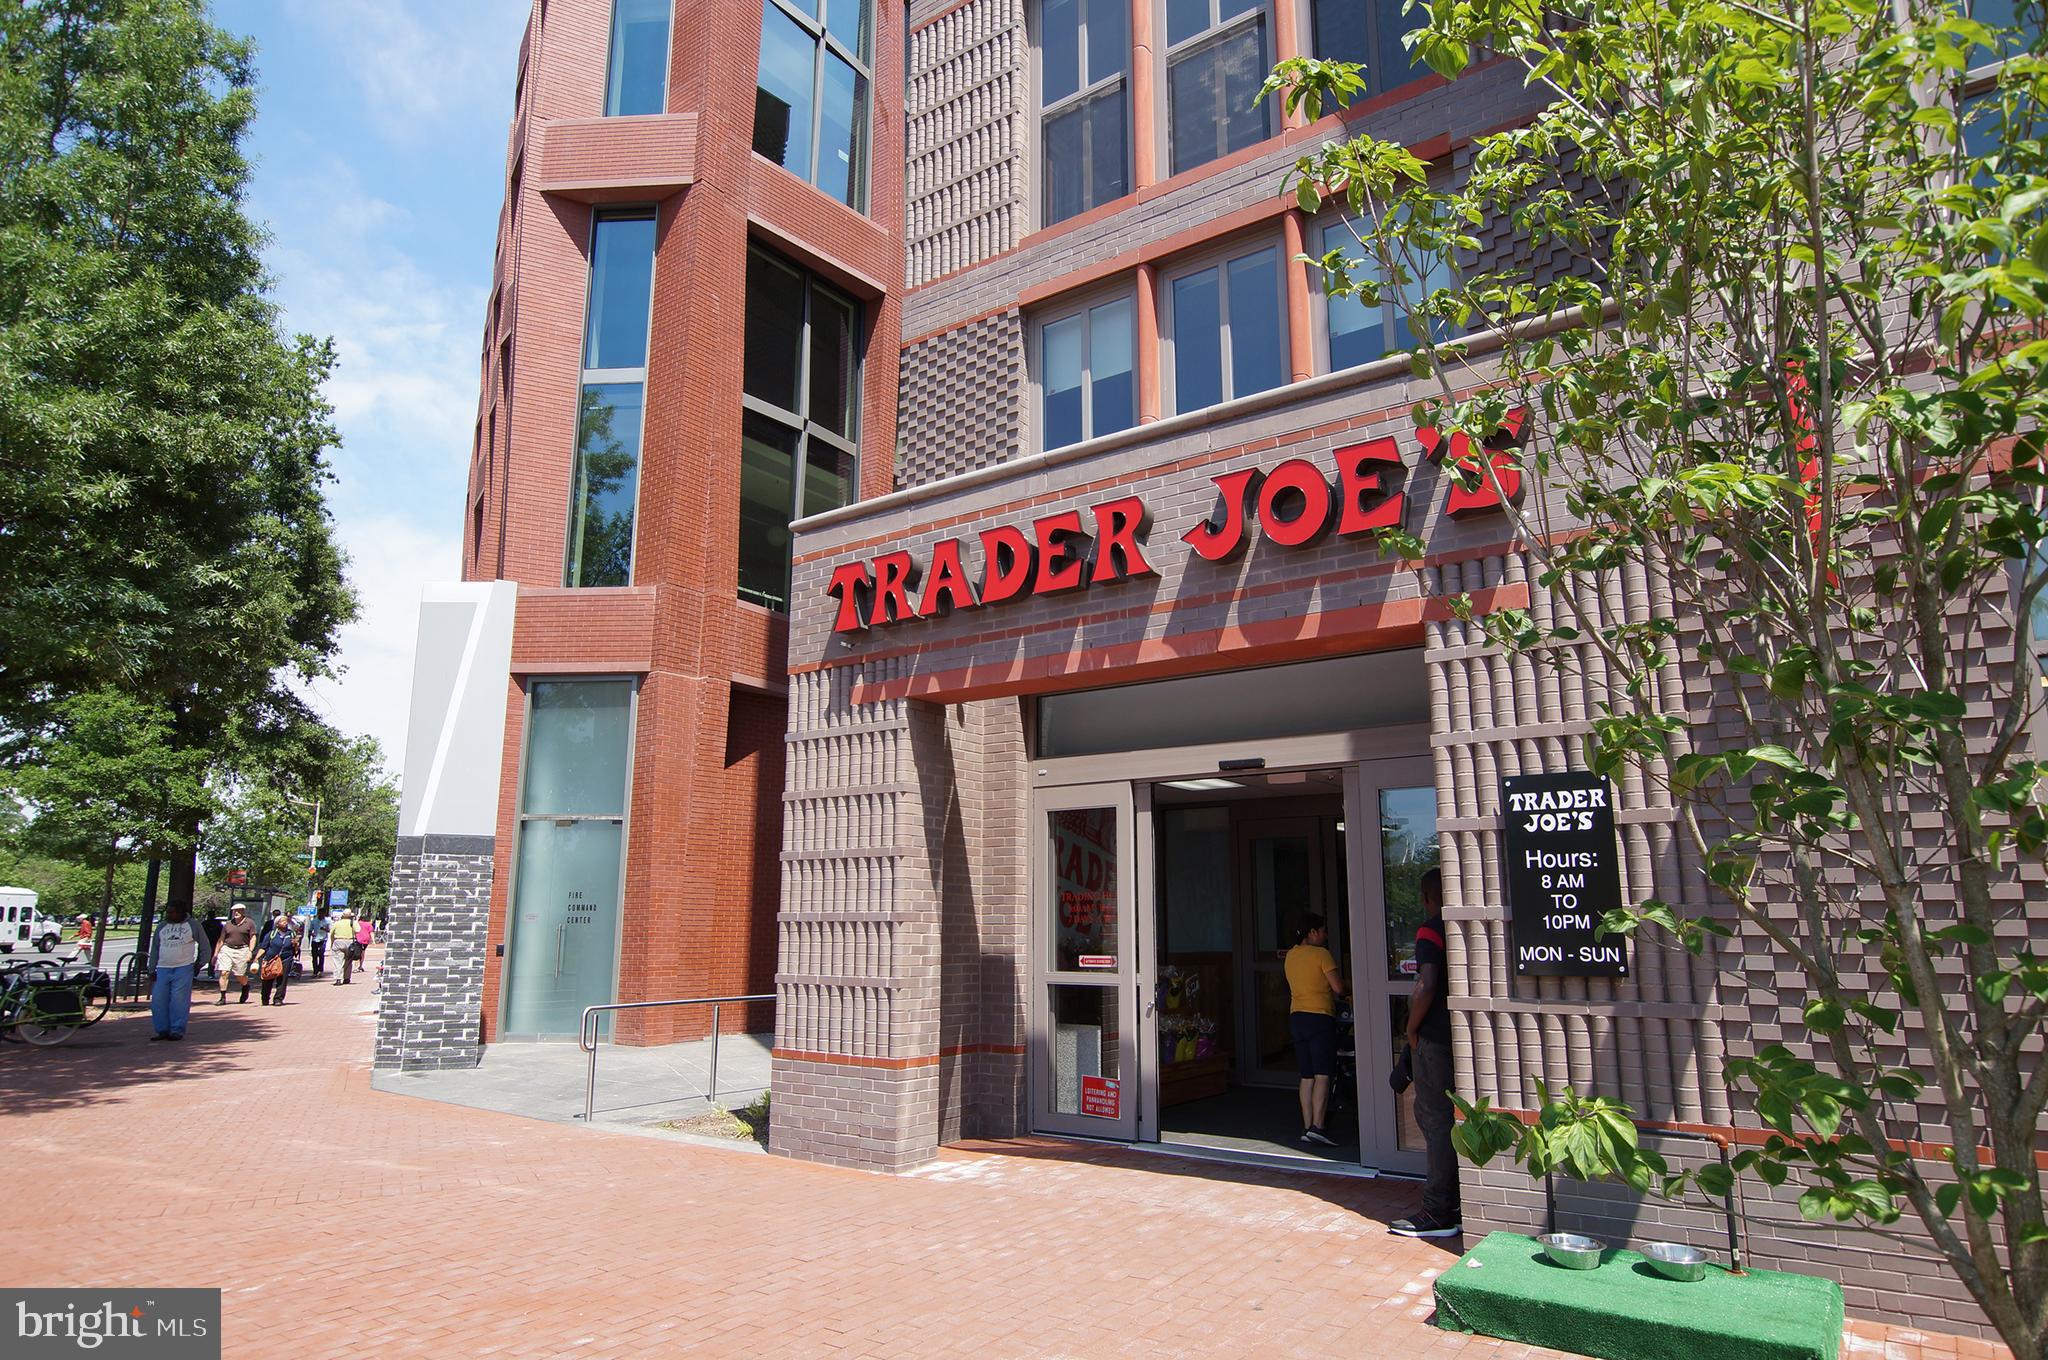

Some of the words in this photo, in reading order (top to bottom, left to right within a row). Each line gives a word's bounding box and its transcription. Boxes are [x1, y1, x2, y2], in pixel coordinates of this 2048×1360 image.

[827, 495, 1162, 632] TRADER
[1181, 405, 1530, 561] JOE'S
[1509, 789, 1606, 812] TRADER
[1523, 811, 1594, 833] JOE'S
[1525, 850, 1598, 869] Hours:
[1541, 874, 1552, 889] 8
[1557, 874, 1584, 888] AM
[568, 891, 583, 899] FIRE
[1551, 894, 1577, 908] TO
[567, 904, 597, 912] COMMAND
[567, 916, 591, 924] CENTER
[1543, 915, 1590, 929] 10PM
[1520, 946, 1562, 961] MON
[1579, 947, 1620, 962] SUN
[1085, 1088, 1106, 1096] LOITERING
